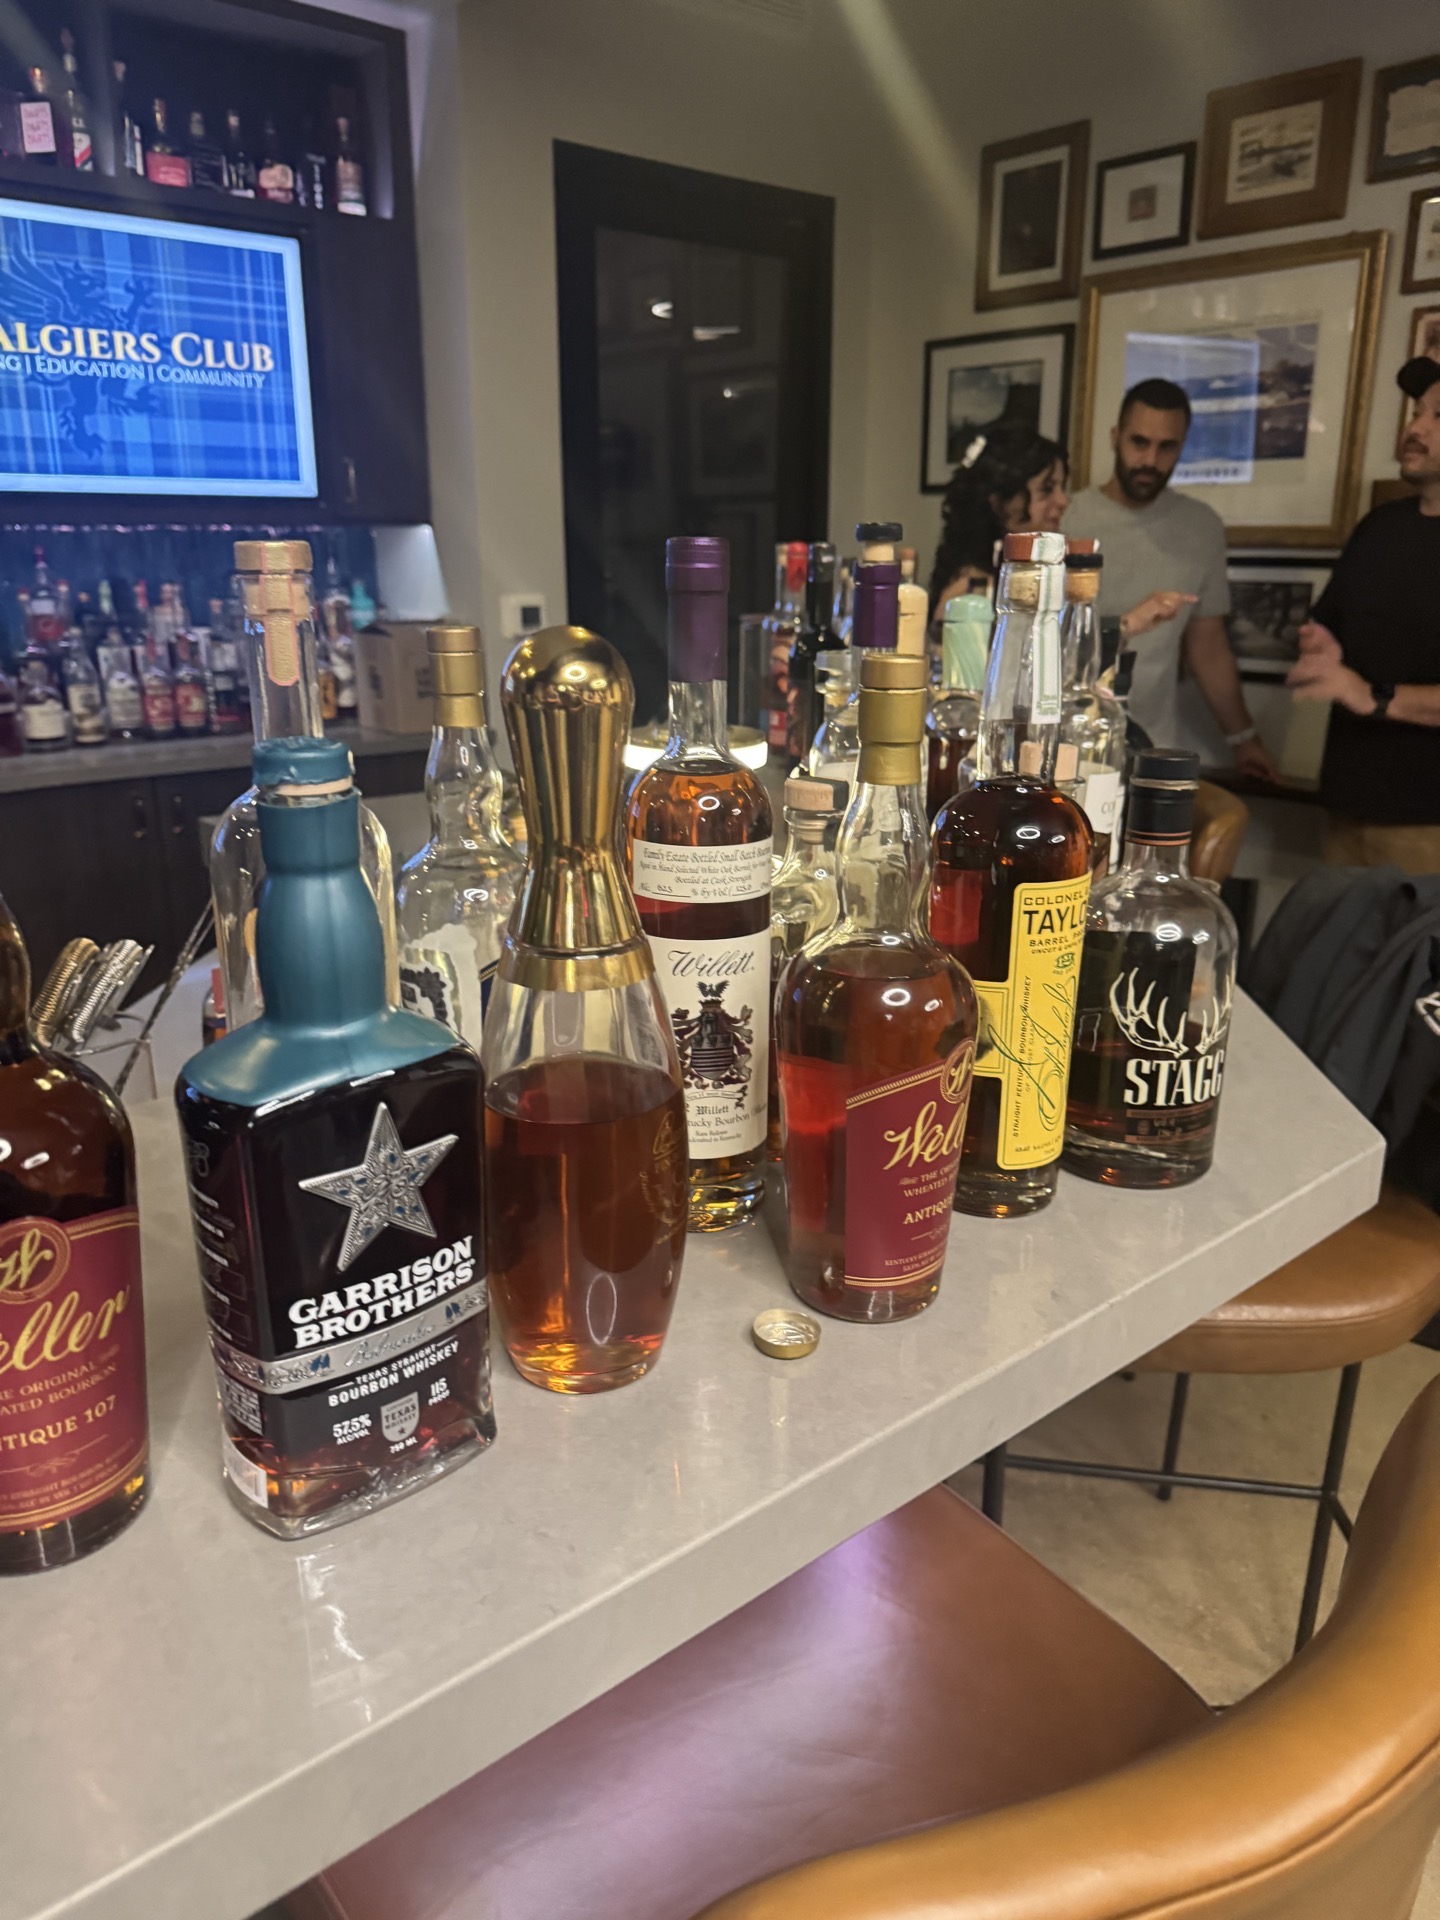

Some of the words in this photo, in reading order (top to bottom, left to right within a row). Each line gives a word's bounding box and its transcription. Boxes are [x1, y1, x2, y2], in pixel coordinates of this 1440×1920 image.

[35, 354, 145, 379] EDUCATION
[156, 364, 266, 389] COMMUNITY
[1023, 890, 1083, 906] COLONEL
[1023, 900, 1087, 935] TAYLO
[1029, 935, 1069, 947] BARREL
[667, 949, 753, 977] Willett
[1012, 1100, 1022, 1138] STRAIGHT
[1019, 1015, 1028, 1054] BOURBON
[1123, 1049, 1225, 1106] STAGG
[696, 1105, 730, 1116] Willett
[715, 1112, 750, 1126] Bourbon
[883, 1101, 965, 1170] Well
[921, 1170, 939, 1182] THE
[288, 1235, 473, 1325] GARRISON
[292, 1260, 474, 1349] BROTHERS
[0, 1284, 130, 1375] eller
[19, 1360, 98, 1397] ORIGINAL
[328, 1373, 399, 1408] BOURBON
[402, 1340, 459, 1379] WHISKEY
[355, 1367, 389, 1386] TEXAS
[391, 1344, 437, 1372] STRAIGHT
[0, 1398, 43, 1416] ATED
[48, 1363, 117, 1404] BOURBON
[428, 1389, 451, 1407] PROOF
[430, 1377, 448, 1397] 115
[0, 1416, 78, 1450] TIQUE
[83, 1394, 116, 1424] 107
[385, 1403, 417, 1423] TEXAS
